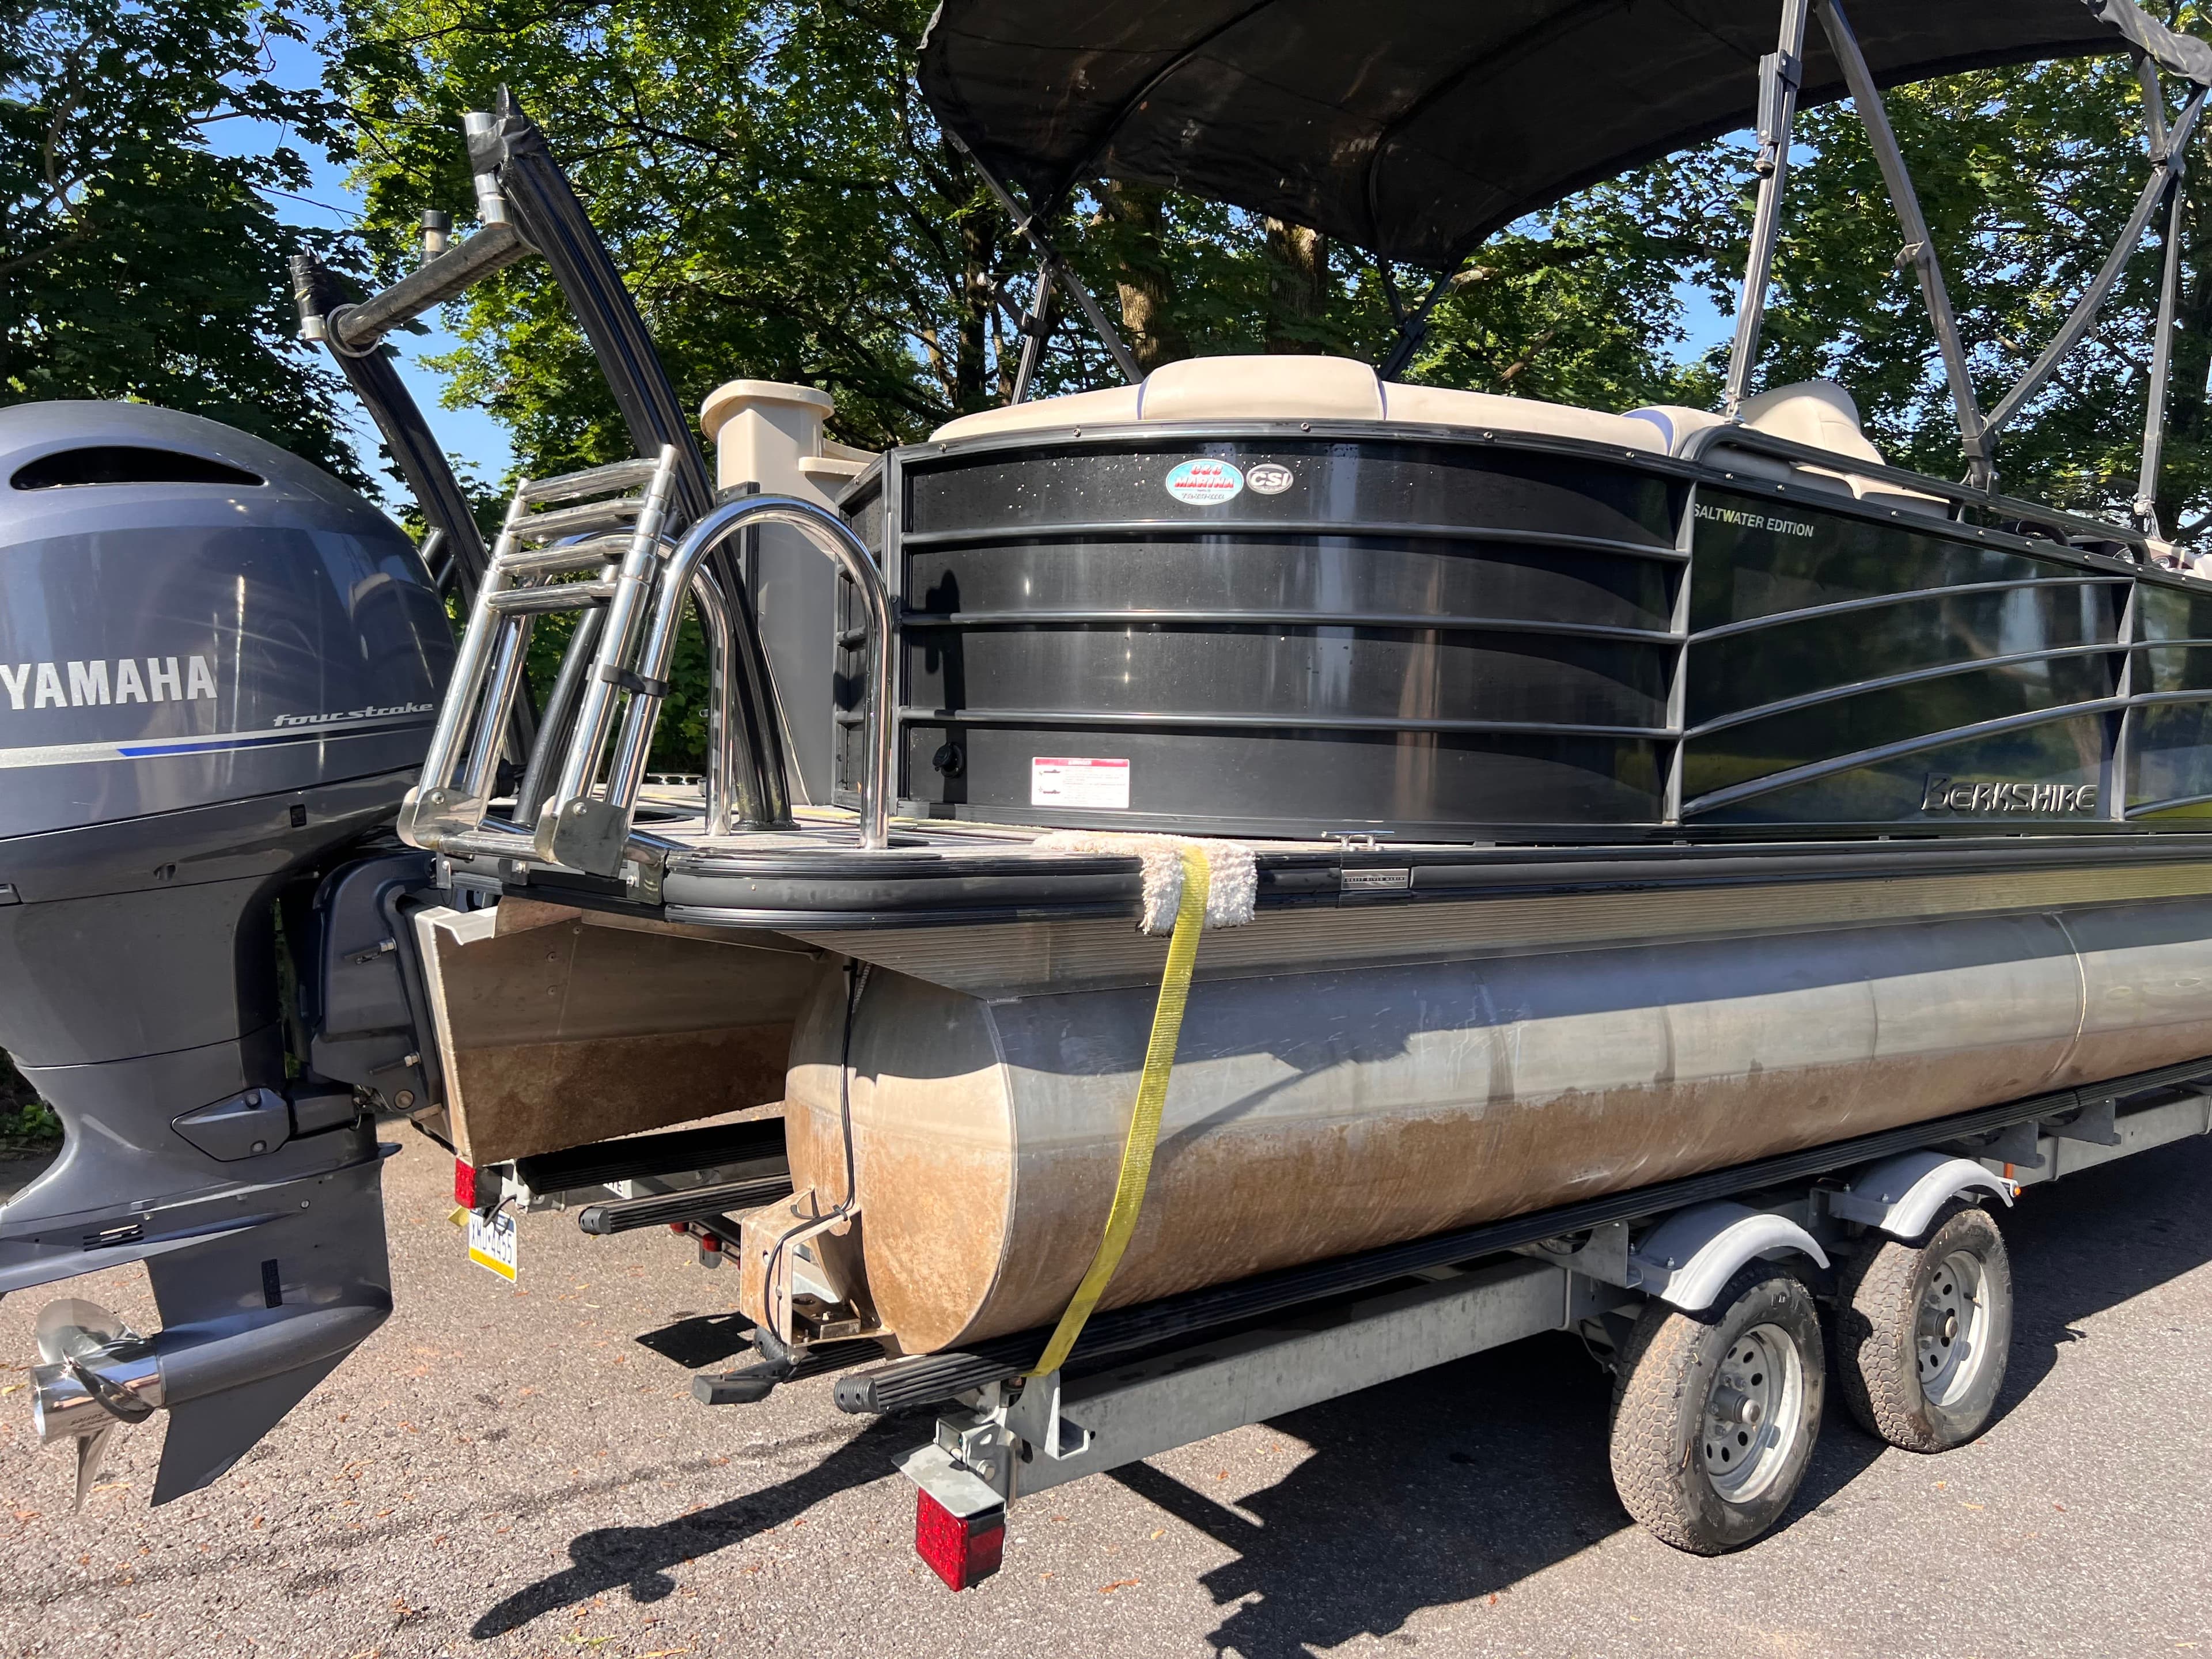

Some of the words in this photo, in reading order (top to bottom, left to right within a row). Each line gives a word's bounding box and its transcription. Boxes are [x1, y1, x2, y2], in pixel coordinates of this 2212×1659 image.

[1191, 464, 1222, 475] C&C
[1251, 472, 1289, 486] CSI
[1174, 477, 1234, 488] MARINA
[1695, 503, 1764, 528] SALTWATER
[1766, 518, 1814, 537] EDITION
[0, 655, 218, 710] YAMAHA
[1921, 772, 2098, 812] BERKSHIRE
